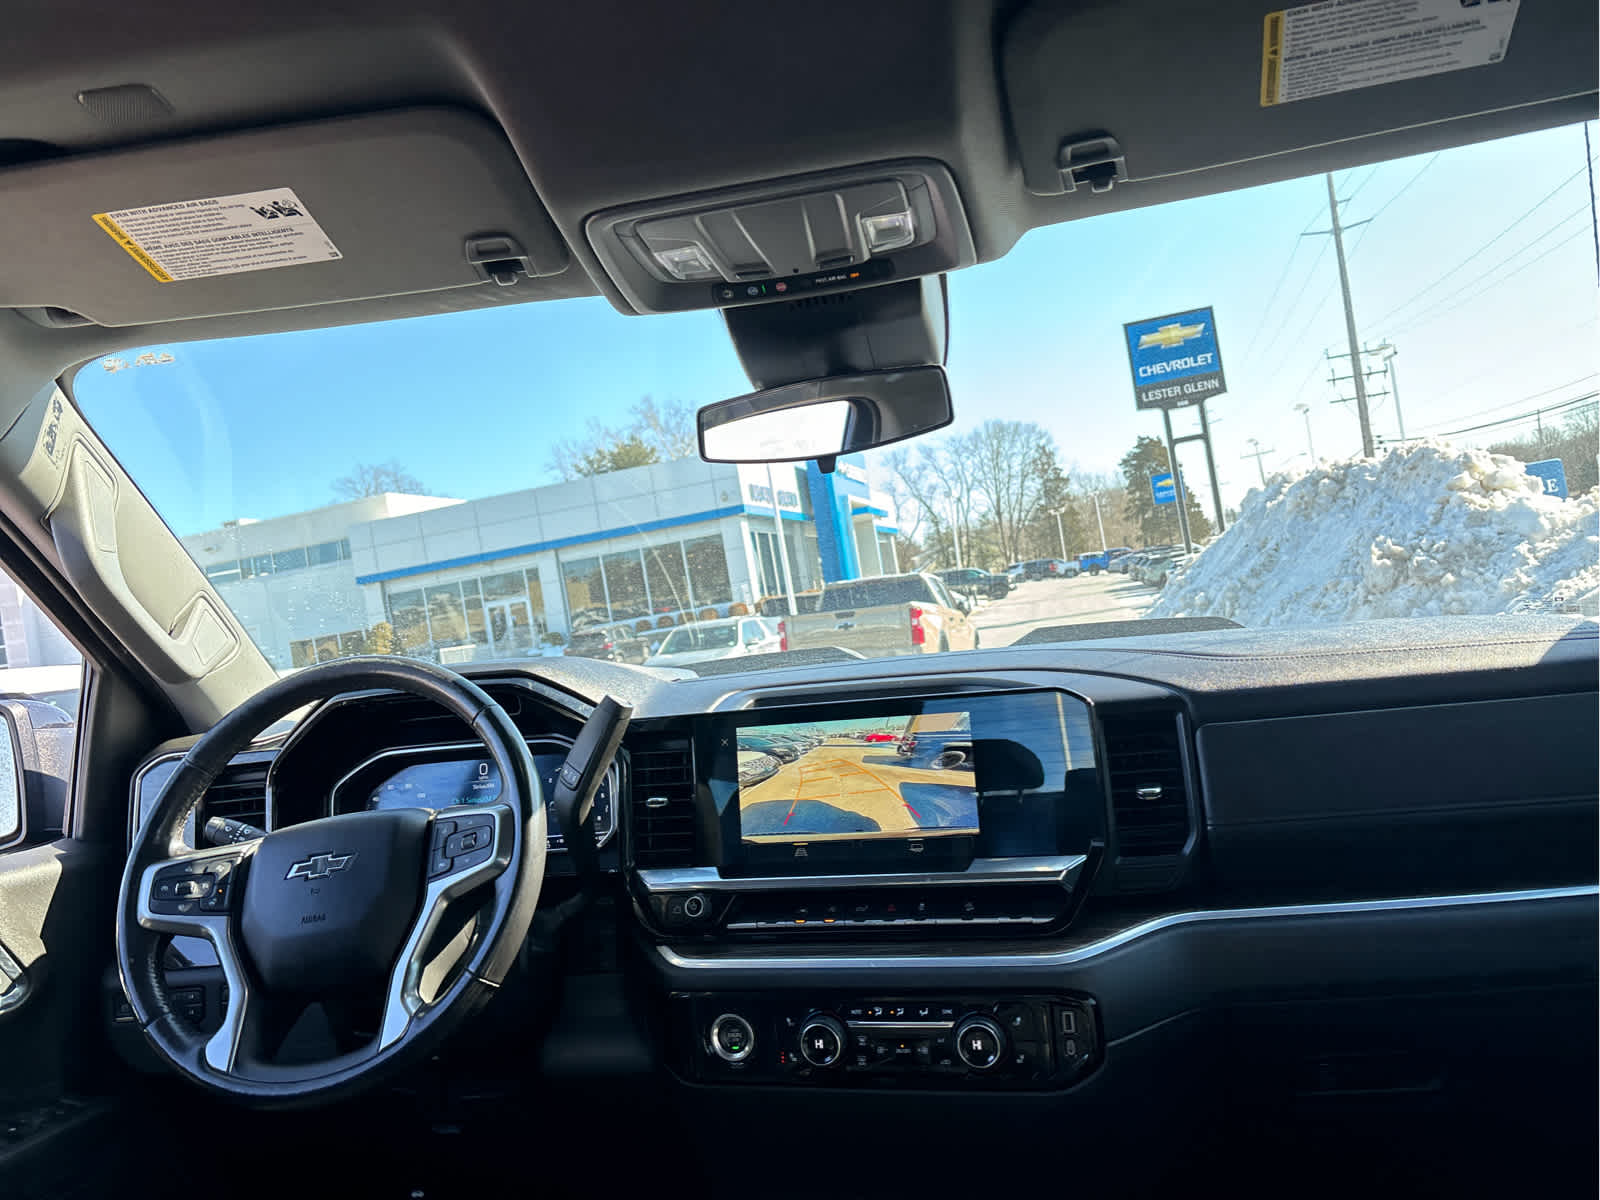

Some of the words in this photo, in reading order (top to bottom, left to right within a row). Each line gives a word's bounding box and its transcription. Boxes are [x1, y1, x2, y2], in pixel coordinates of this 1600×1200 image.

[1139, 353, 1213, 377] CHEVROLET
[1142, 385, 1181, 402] LESTER
[1184, 378, 1219, 394] GLENN
[479, 763, 488, 775] 0
